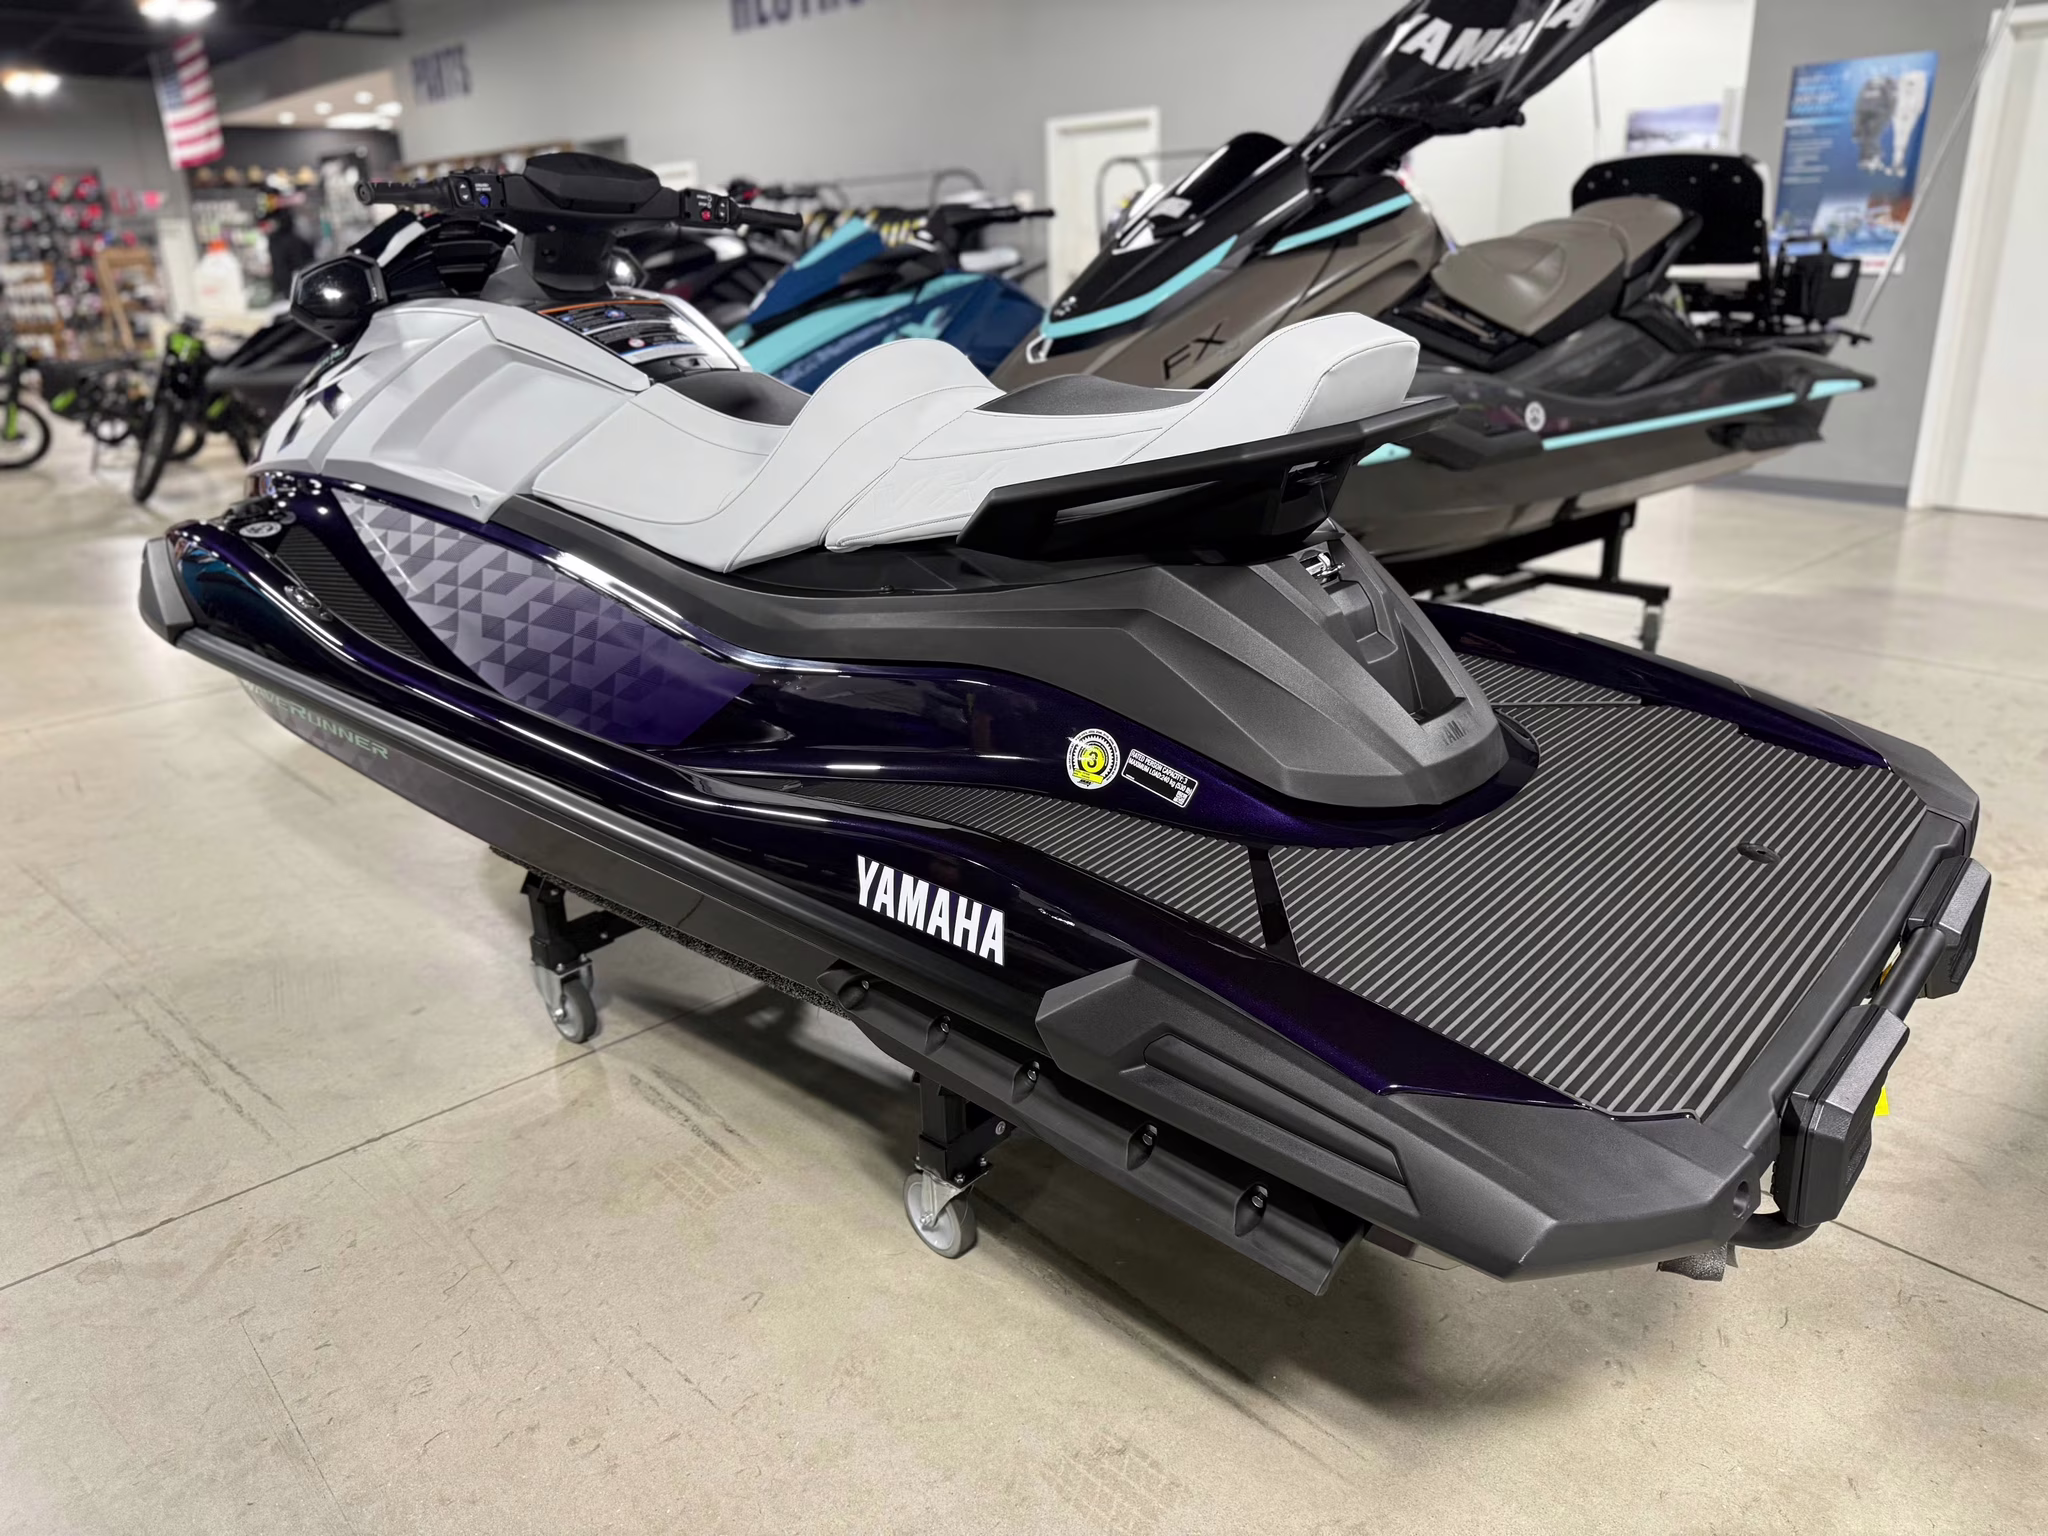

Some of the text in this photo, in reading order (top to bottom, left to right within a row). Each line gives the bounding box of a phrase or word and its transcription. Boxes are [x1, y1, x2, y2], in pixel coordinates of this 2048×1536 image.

[1382, 0, 1598, 71] YAMAA
[1163, 321, 1226, 380] FX
[1087, 751, 1098, 768] 3
[1145, 757, 1163, 772] PERSON
[857, 855, 1005, 966] YAMAHA
